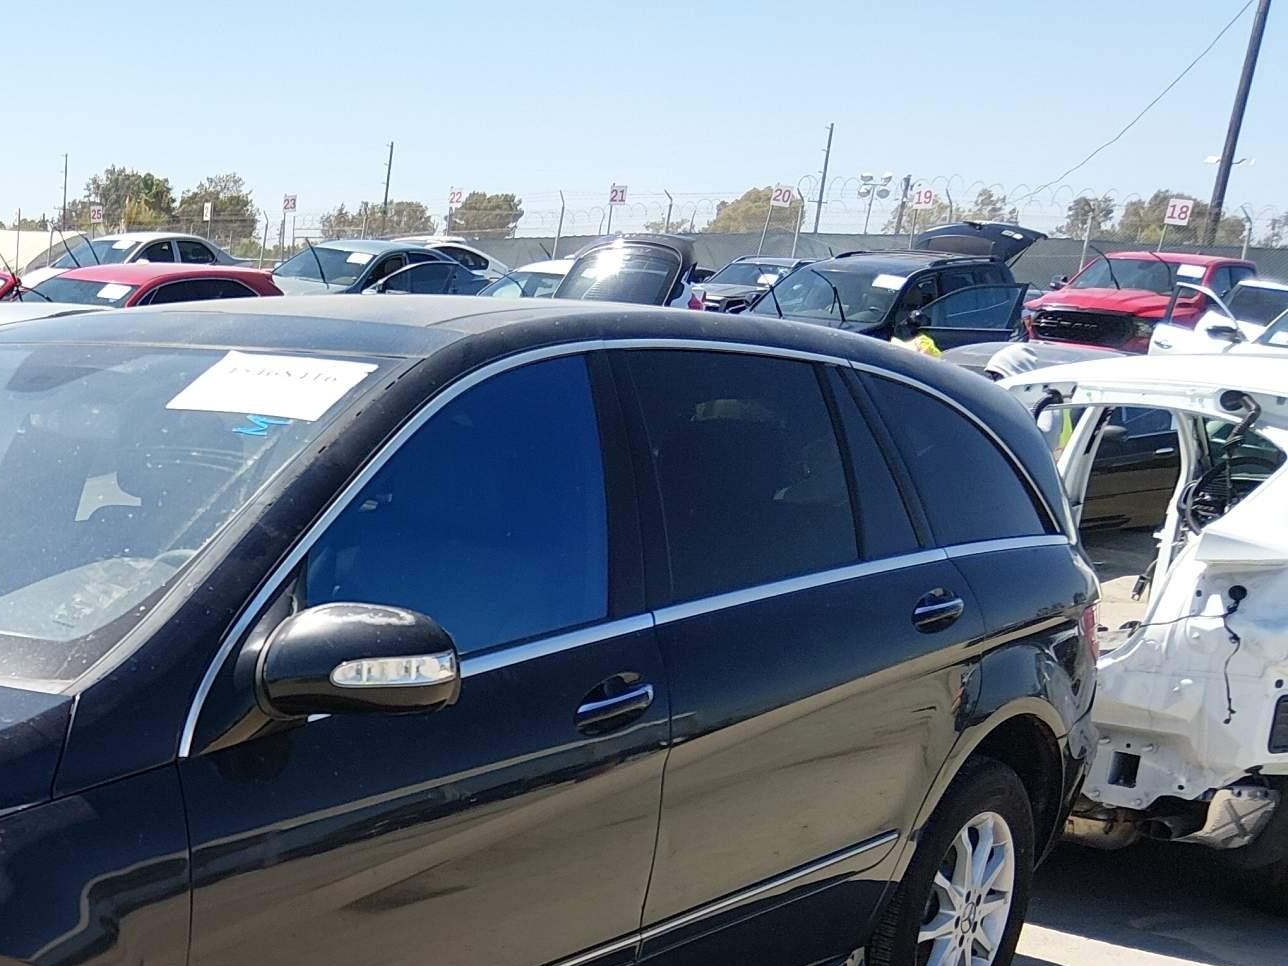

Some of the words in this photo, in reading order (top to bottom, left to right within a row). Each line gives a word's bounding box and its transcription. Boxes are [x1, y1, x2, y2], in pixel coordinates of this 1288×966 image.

[449, 191, 463, 203] 22
[610, 189, 626, 202] 21
[772, 188, 791, 203] 20
[915, 190, 934, 204] 19
[283, 199, 296, 210] 23
[91, 209, 103, 220] 25
[1167, 203, 1190, 220] 18
